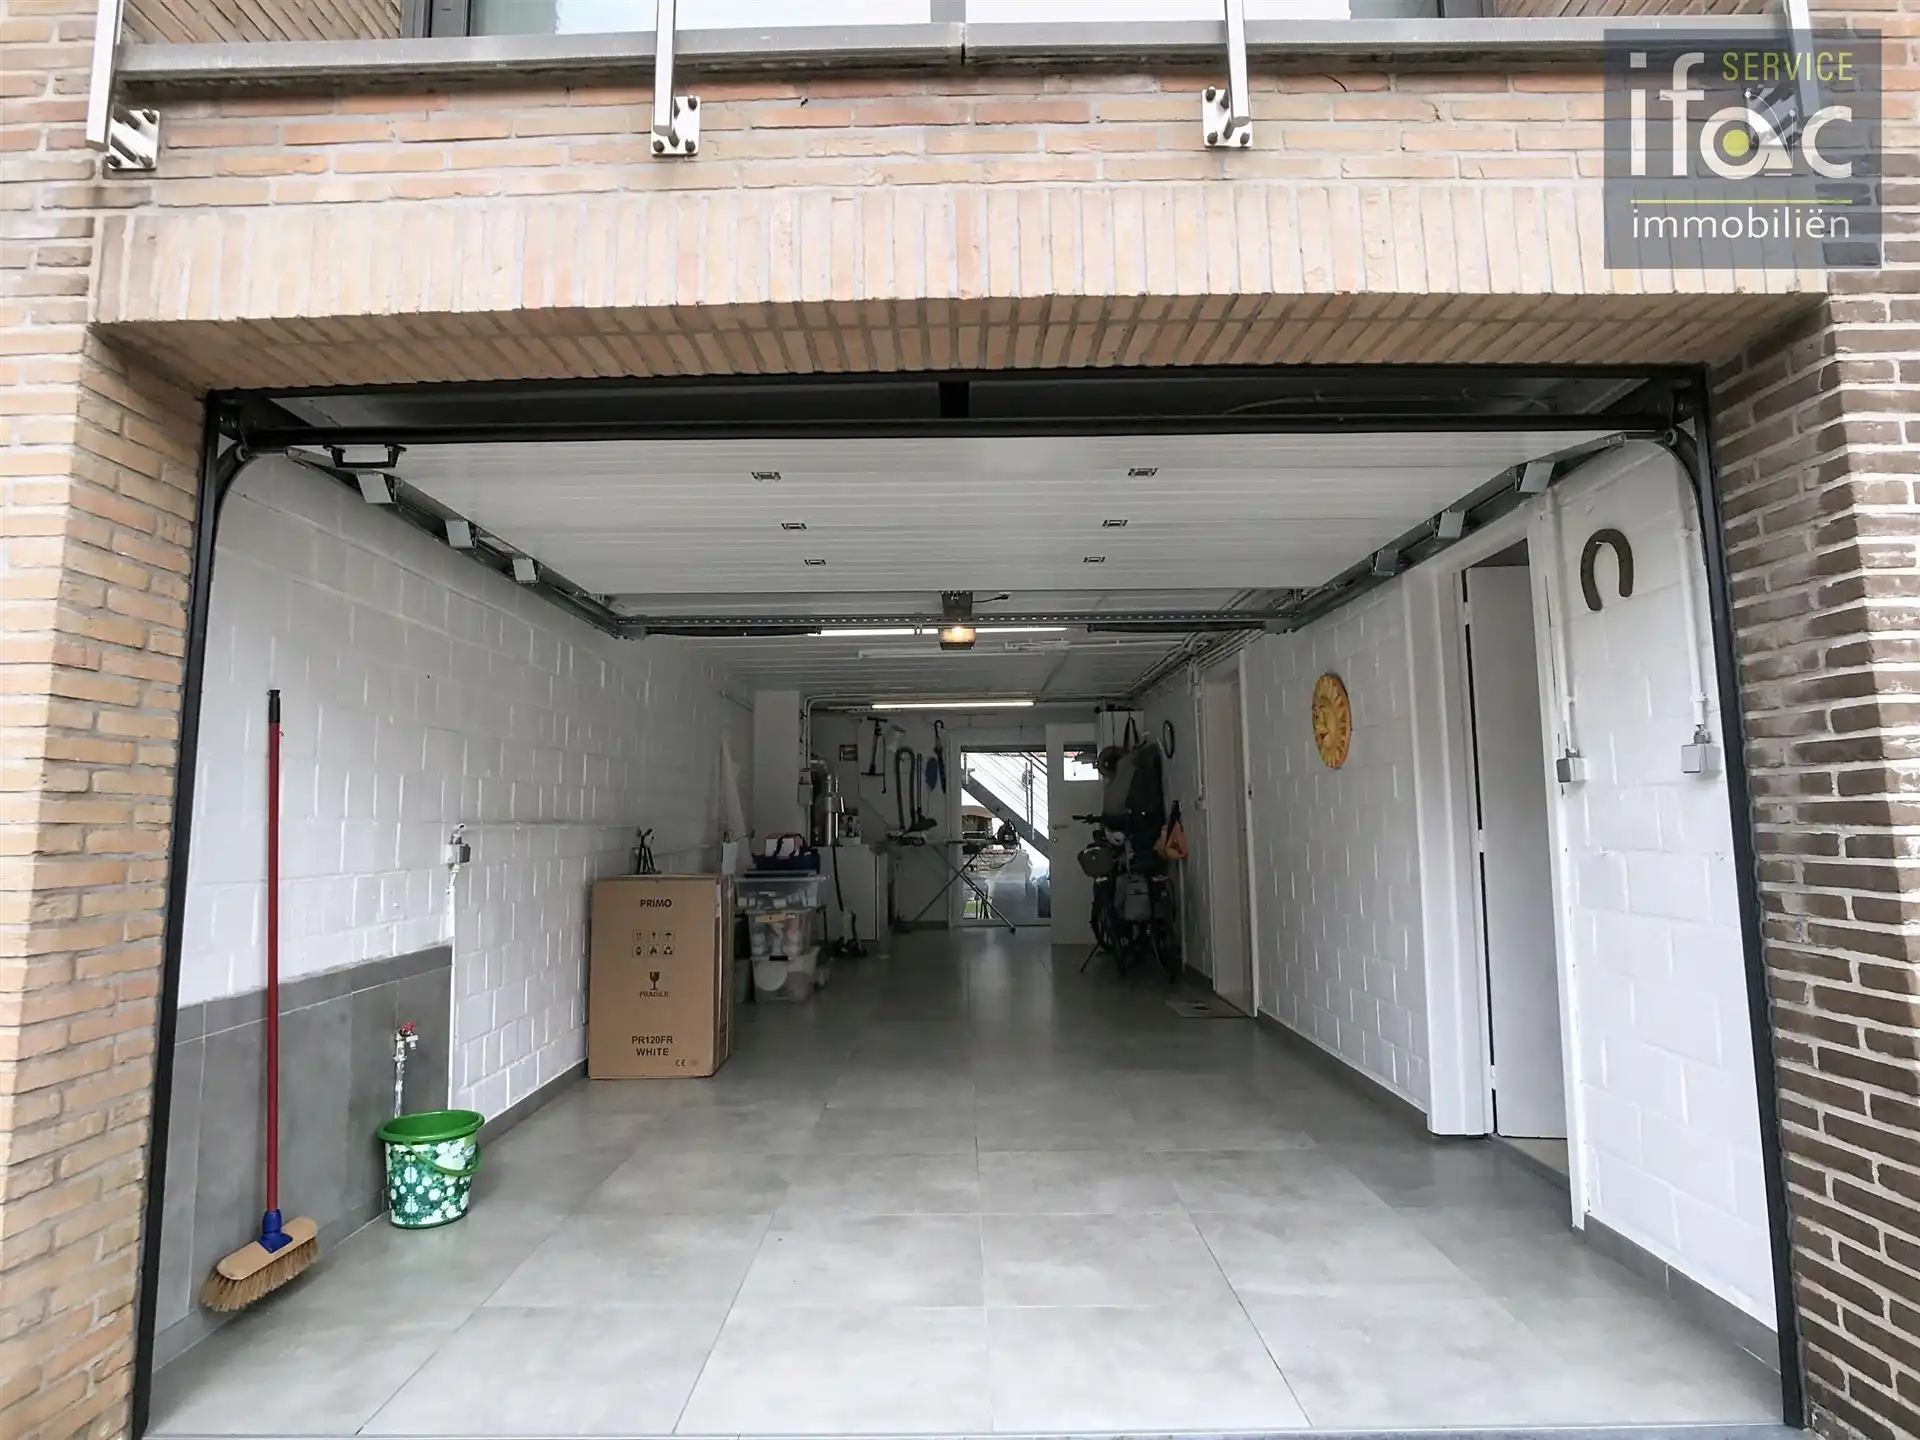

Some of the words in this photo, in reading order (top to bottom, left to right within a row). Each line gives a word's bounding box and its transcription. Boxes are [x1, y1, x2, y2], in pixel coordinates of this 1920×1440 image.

[639, 898, 673, 908] PRIMO
[631, 1035, 674, 1045] PR120FR
[636, 1047, 670, 1057] WHITE
